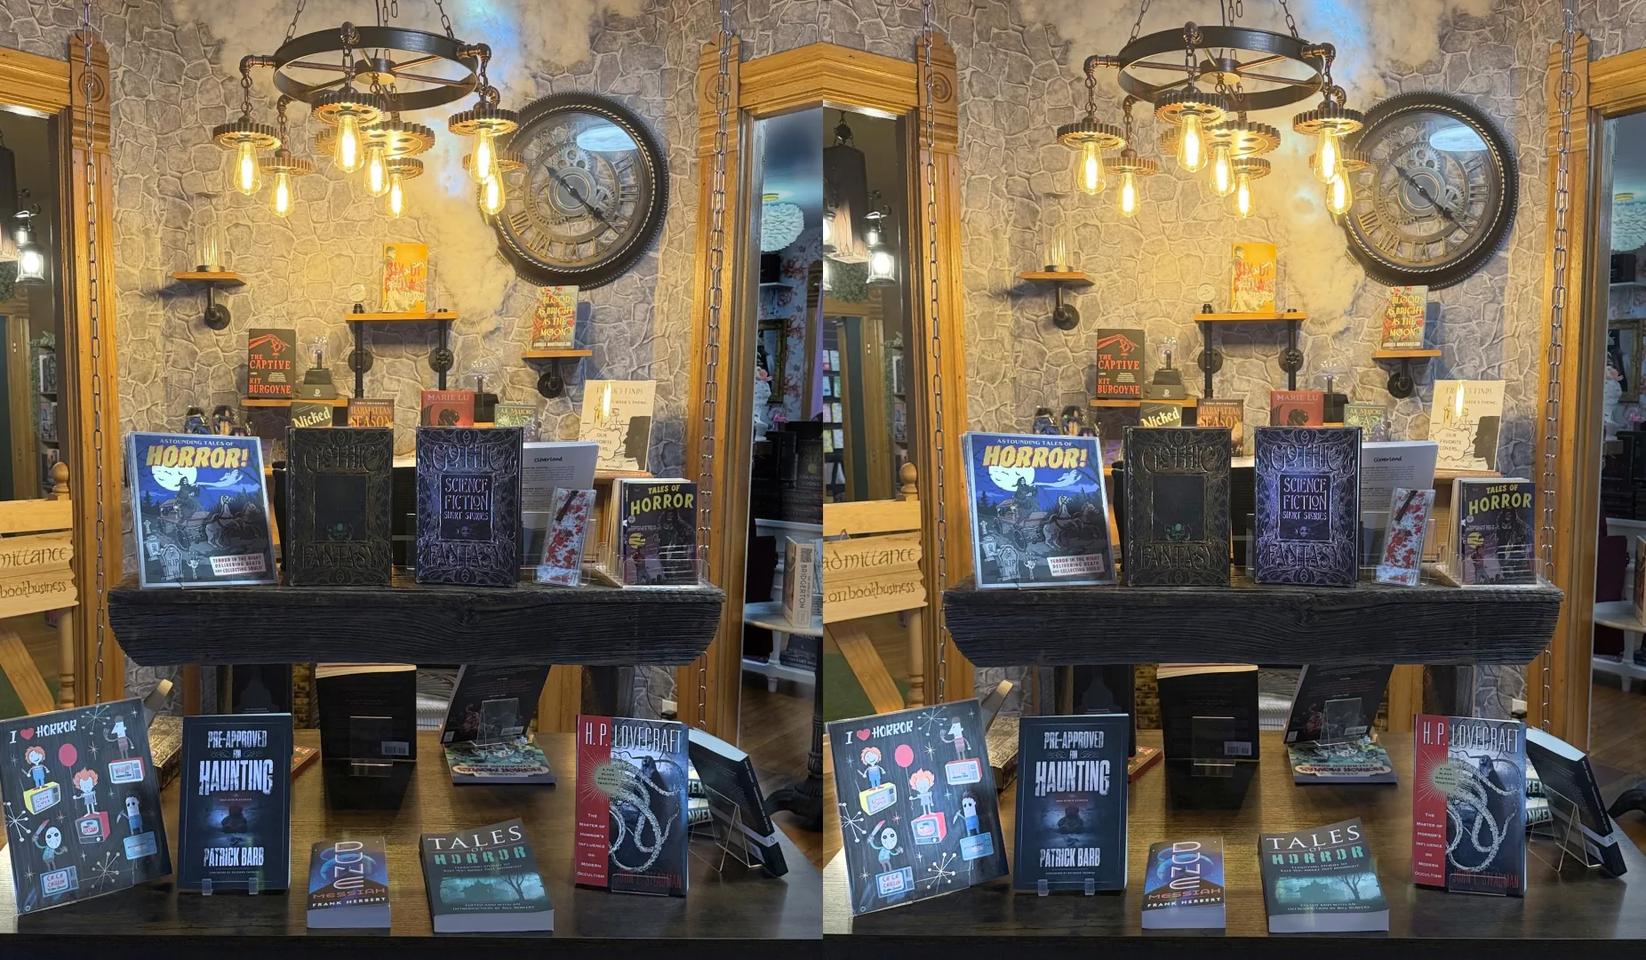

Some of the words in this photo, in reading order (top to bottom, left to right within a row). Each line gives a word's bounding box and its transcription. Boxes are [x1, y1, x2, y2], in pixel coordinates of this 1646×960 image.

[250, 360, 291, 370] CAPTIVE
[1098, 360, 1140, 370] CAPTIVE
[249, 384, 291, 394] BURGOYNE
[1097, 384, 1140, 395] BURGOYNE
[292, 406, 331, 427] Nicked
[350, 416, 393, 427] SEASON
[1141, 406, 1180, 427] Nicked
[146, 445, 249, 468] HORROR!
[304, 445, 377, 473] GOTHIC
[432, 442, 504, 472] GOTHIC
[983, 445, 1088, 469] HORROR!
[1142, 444, 1216, 473] GOTHIC
[1271, 442, 1344, 472] GOTHIC
[445, 478, 488, 493] SCIENCE
[648, 485, 669, 494] TALES
[1283, 478, 1326, 493] SCIENCE
[1486, 485, 1507, 494] TALES
[1509, 484, 1519, 492] OF
[444, 491, 489, 511] FICTION
[630, 494, 694, 515] HORROR
[1283, 491, 1327, 511] FICTION
[1468, 493, 1532, 515] HORROR
[430, 544, 501, 568] FANTASY
[1269, 544, 1339, 568] FANTASY
[35, 719, 77, 738] HORROR
[872, 720, 914, 739] HORROR
[208, 730, 267, 748] PRE-APPROVED
[614, 727, 682, 753] LOVECRAFT
[1044, 731, 1104, 749] PRE-APPROVED
[1451, 725, 1519, 753] LOVECRAFT
[198, 759, 274, 796] HAUNTING
[1035, 760, 1110, 797] HAUNTING
[427, 825, 522, 850] TALES
[1266, 825, 1360, 850] TALES
[203, 847, 240, 867] PATRICK
[241, 847, 264, 867] BARB
[434, 846, 526, 865] HORROR
[1039, 849, 1076, 868] PATRICK
[1078, 848, 1101, 867] BARB
[1272, 846, 1364, 865] HORROR
[312, 900, 342, 908] FRANK
[346, 897, 386, 905] HERBERT
[313, 888, 385, 899] MESSIAH
[1148, 888, 1221, 900] MESSIAH
[1181, 897, 1221, 905] HERBERT
